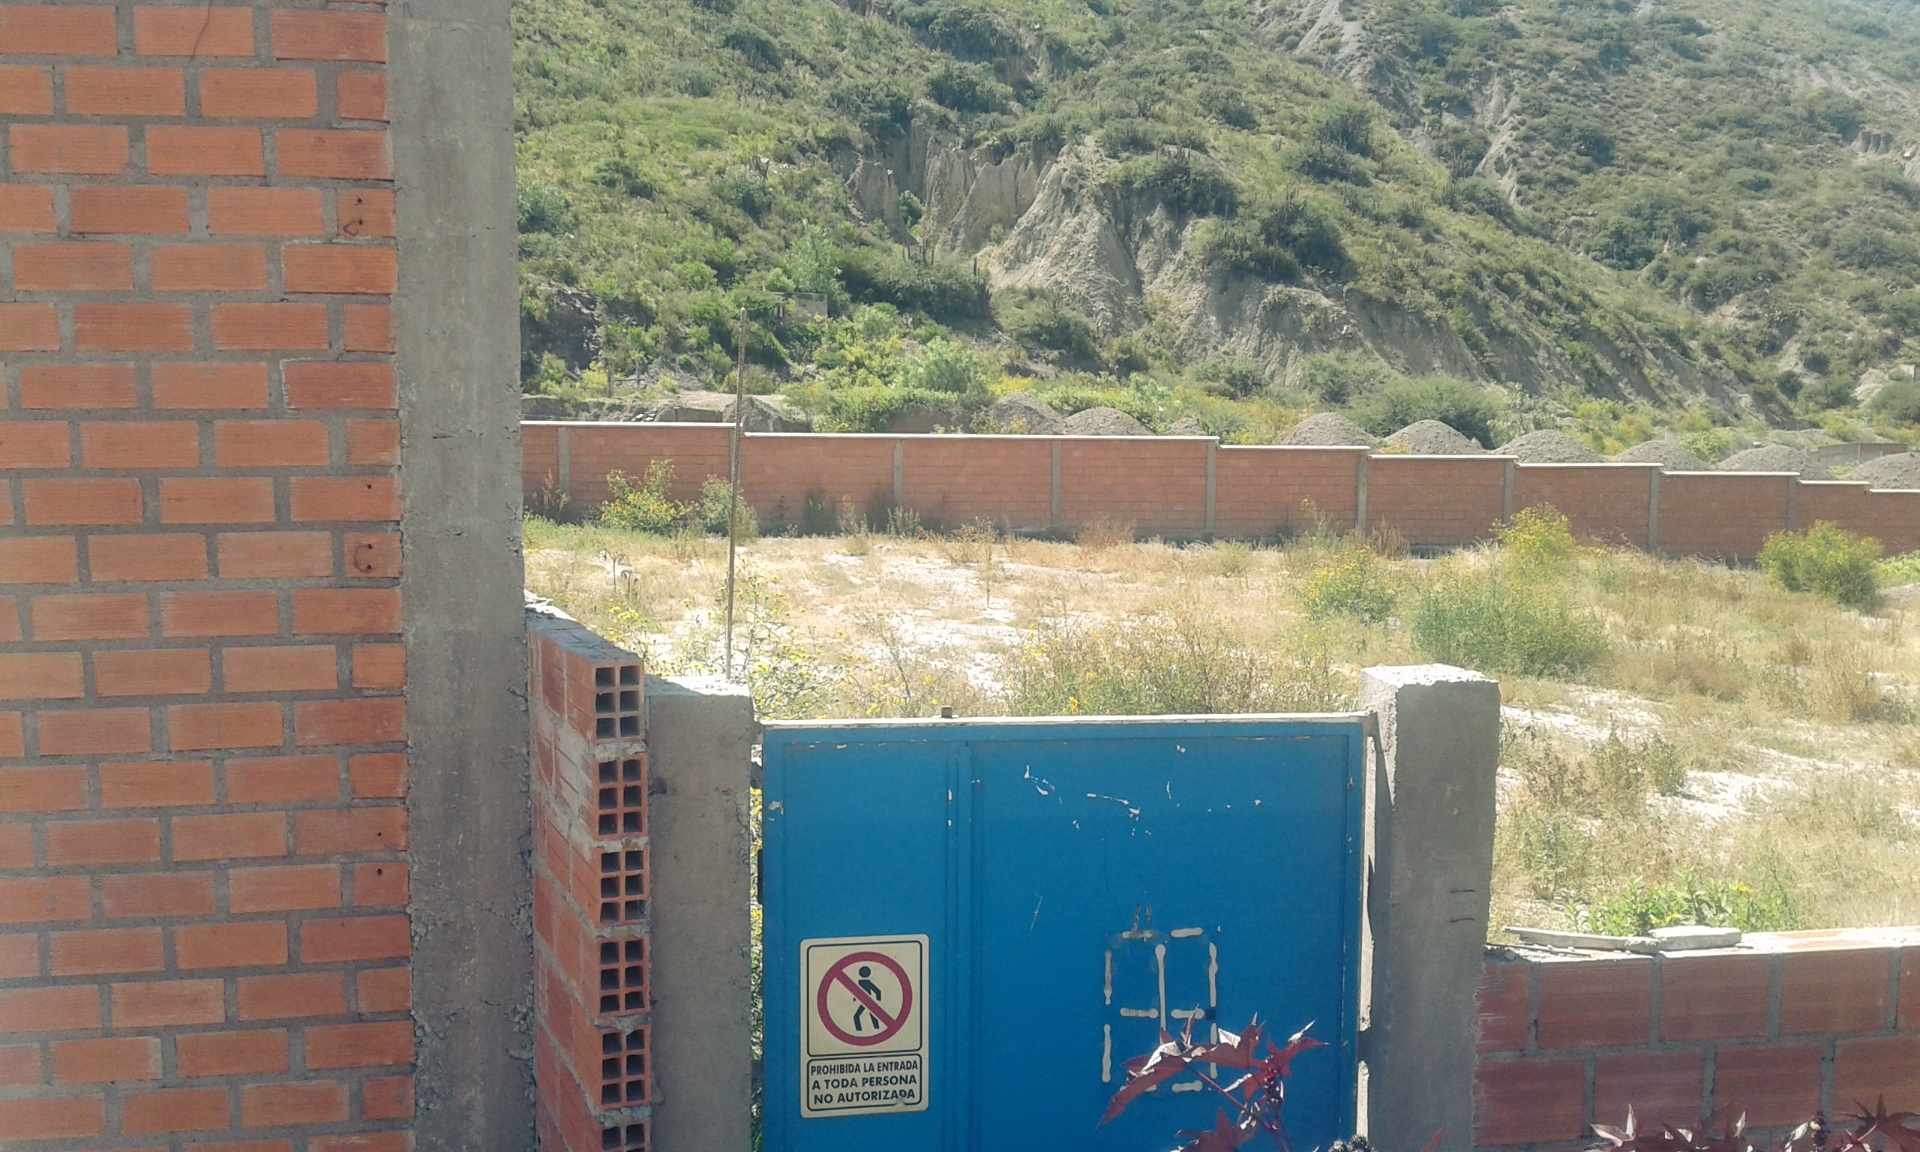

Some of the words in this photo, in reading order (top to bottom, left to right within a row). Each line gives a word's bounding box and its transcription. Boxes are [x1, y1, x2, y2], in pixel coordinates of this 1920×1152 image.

[810, 1063, 861, 1076] PROHIBIDA
[863, 1062, 875, 1073] LA
[877, 1060, 918, 1072] ENTRADA
[811, 1080, 821, 1090] A
[824, 1078, 858, 1089] TODA
[861, 1074, 917, 1087] PERSONA
[813, 1094, 834, 1105] NO
[837, 1089, 916, 1103] AUTORIZADA
